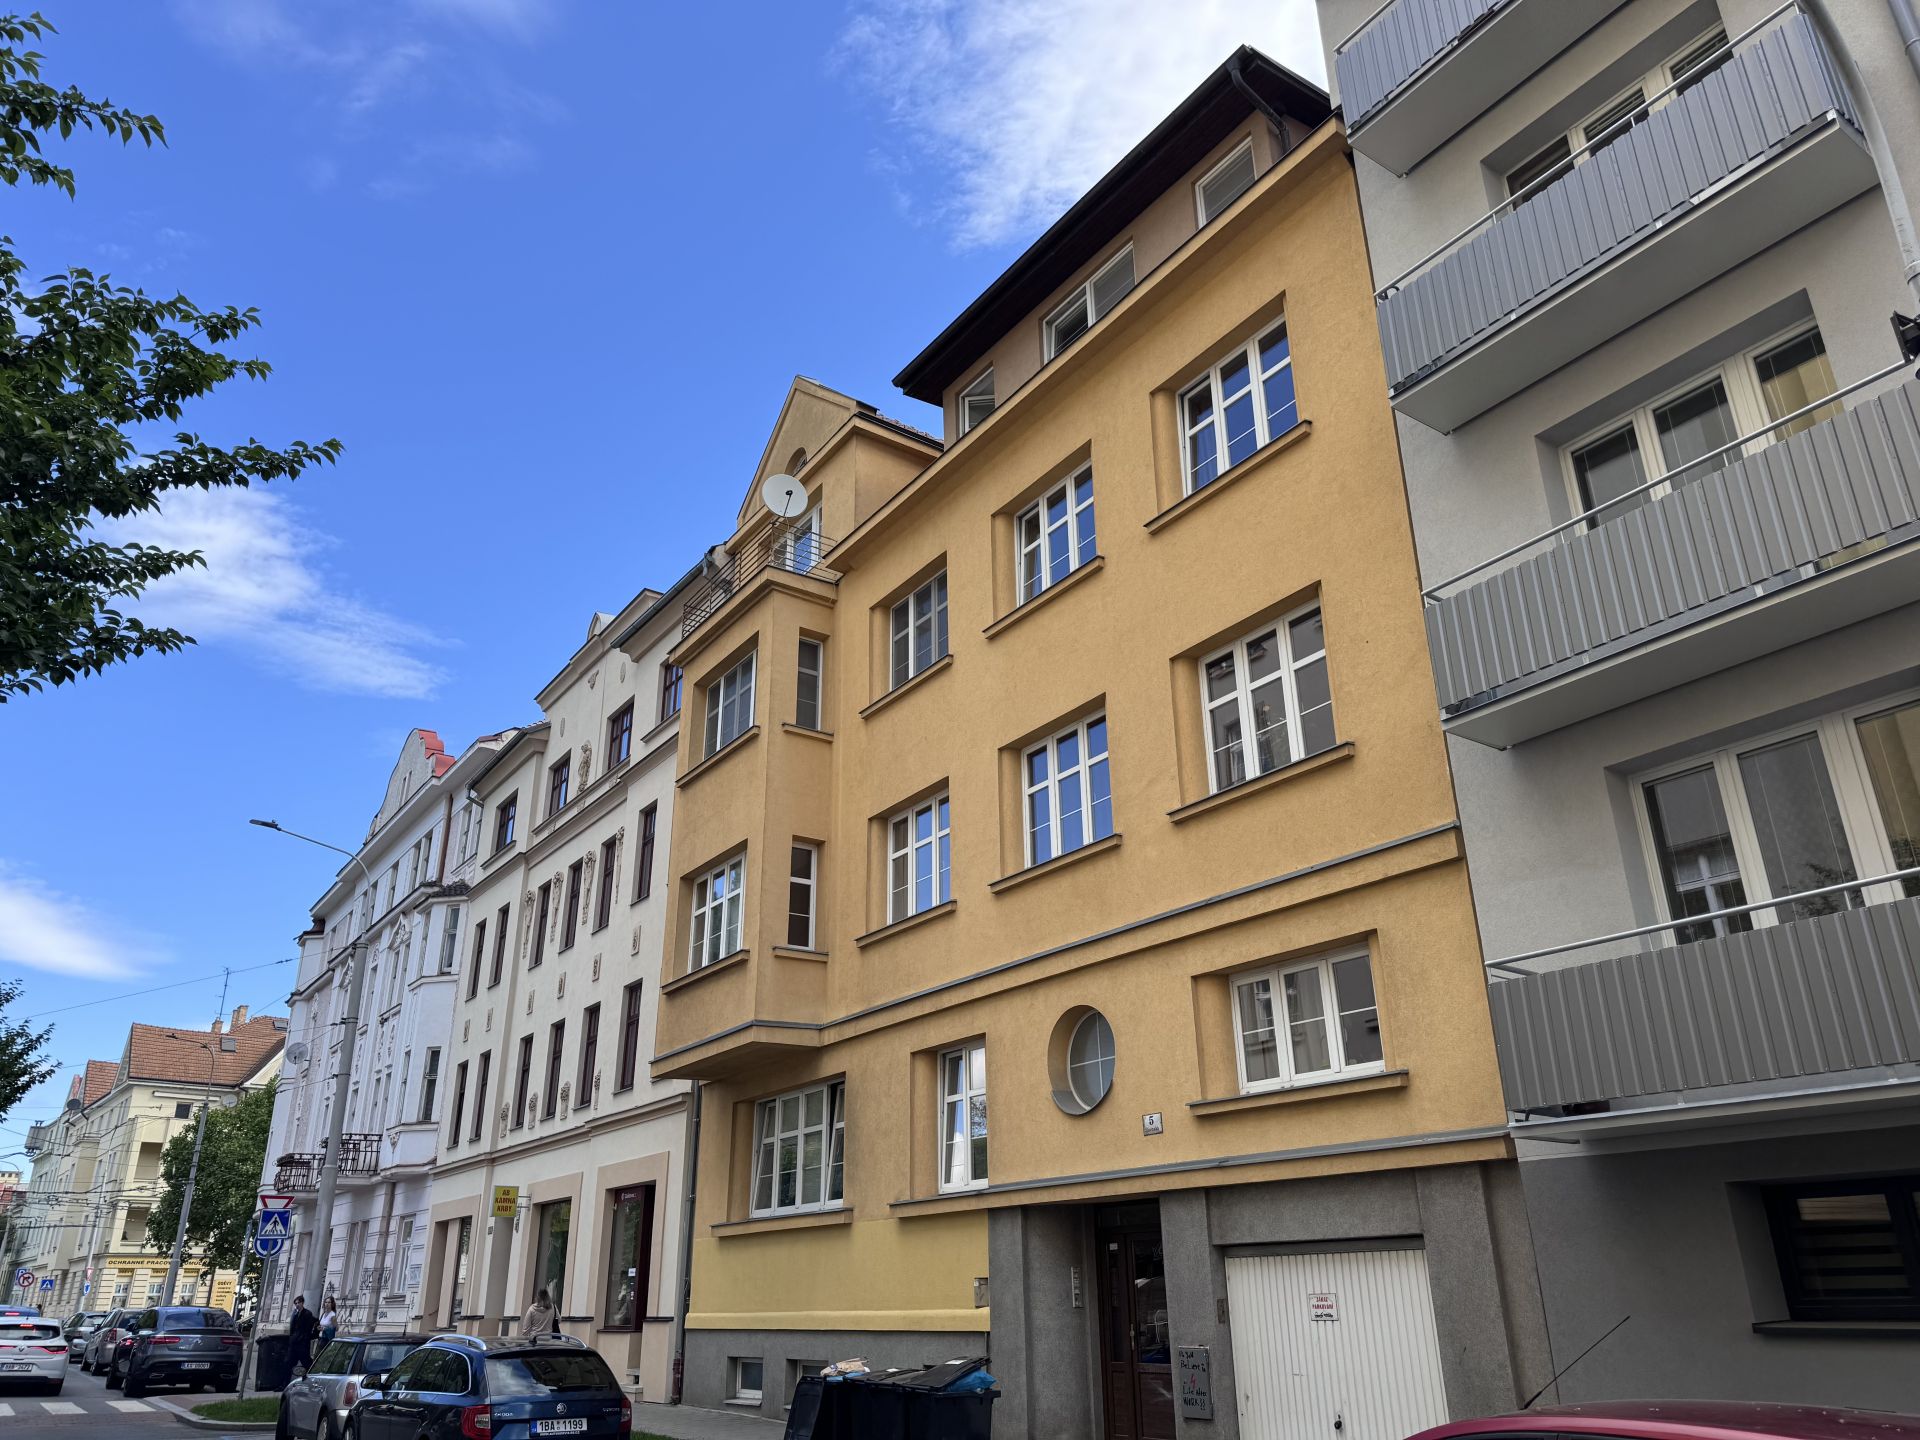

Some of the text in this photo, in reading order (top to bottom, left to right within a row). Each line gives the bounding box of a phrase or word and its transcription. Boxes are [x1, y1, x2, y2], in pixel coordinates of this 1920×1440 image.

[1149, 1115, 1154, 1125] 5
[539, 1419, 583, 1432] 1BA 1199
